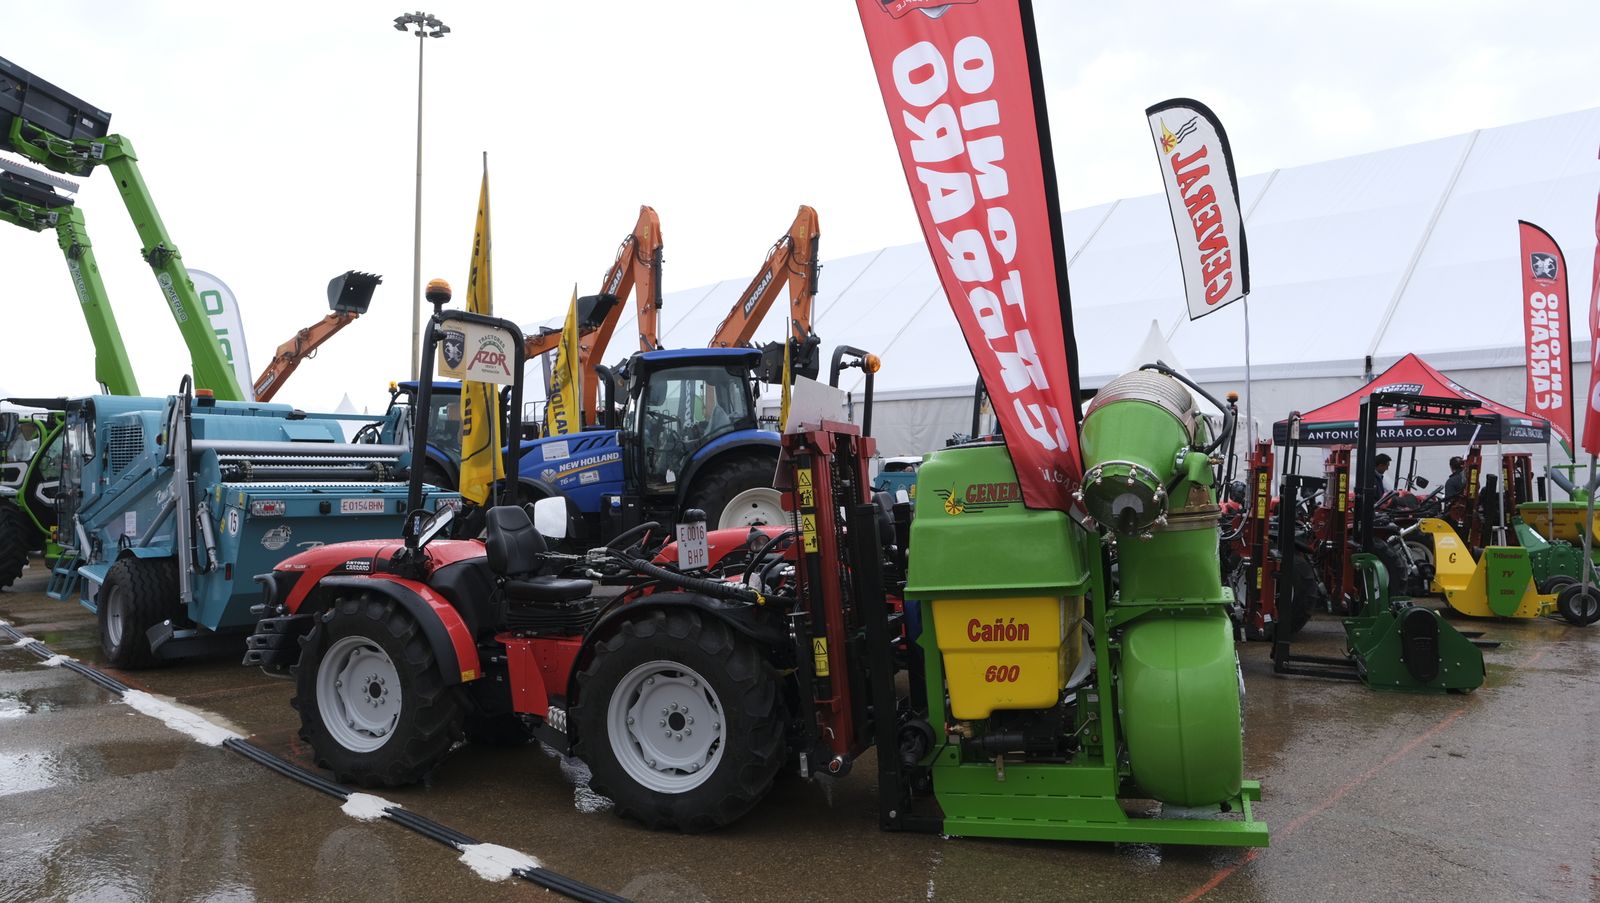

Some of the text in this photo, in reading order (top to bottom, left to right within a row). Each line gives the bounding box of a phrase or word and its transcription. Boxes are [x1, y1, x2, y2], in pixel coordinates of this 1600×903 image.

[608, 270, 623, 295] SAN
[744, 270, 773, 315] DOOSAN
[167, 286, 188, 322] MERLO
[467, 350, 511, 377] AZOR
[1307, 428, 1457, 440] ANTONIORRARO.COM
[559, 452, 620, 472] NEW HOLLAND
[965, 482, 1023, 503] GENER
[230, 512, 237, 532] 15
[687, 525, 705, 542] 0016
[688, 548, 704, 565] BHP
[967, 617, 1030, 643] Cañón
[984, 664, 1021, 683] 600
